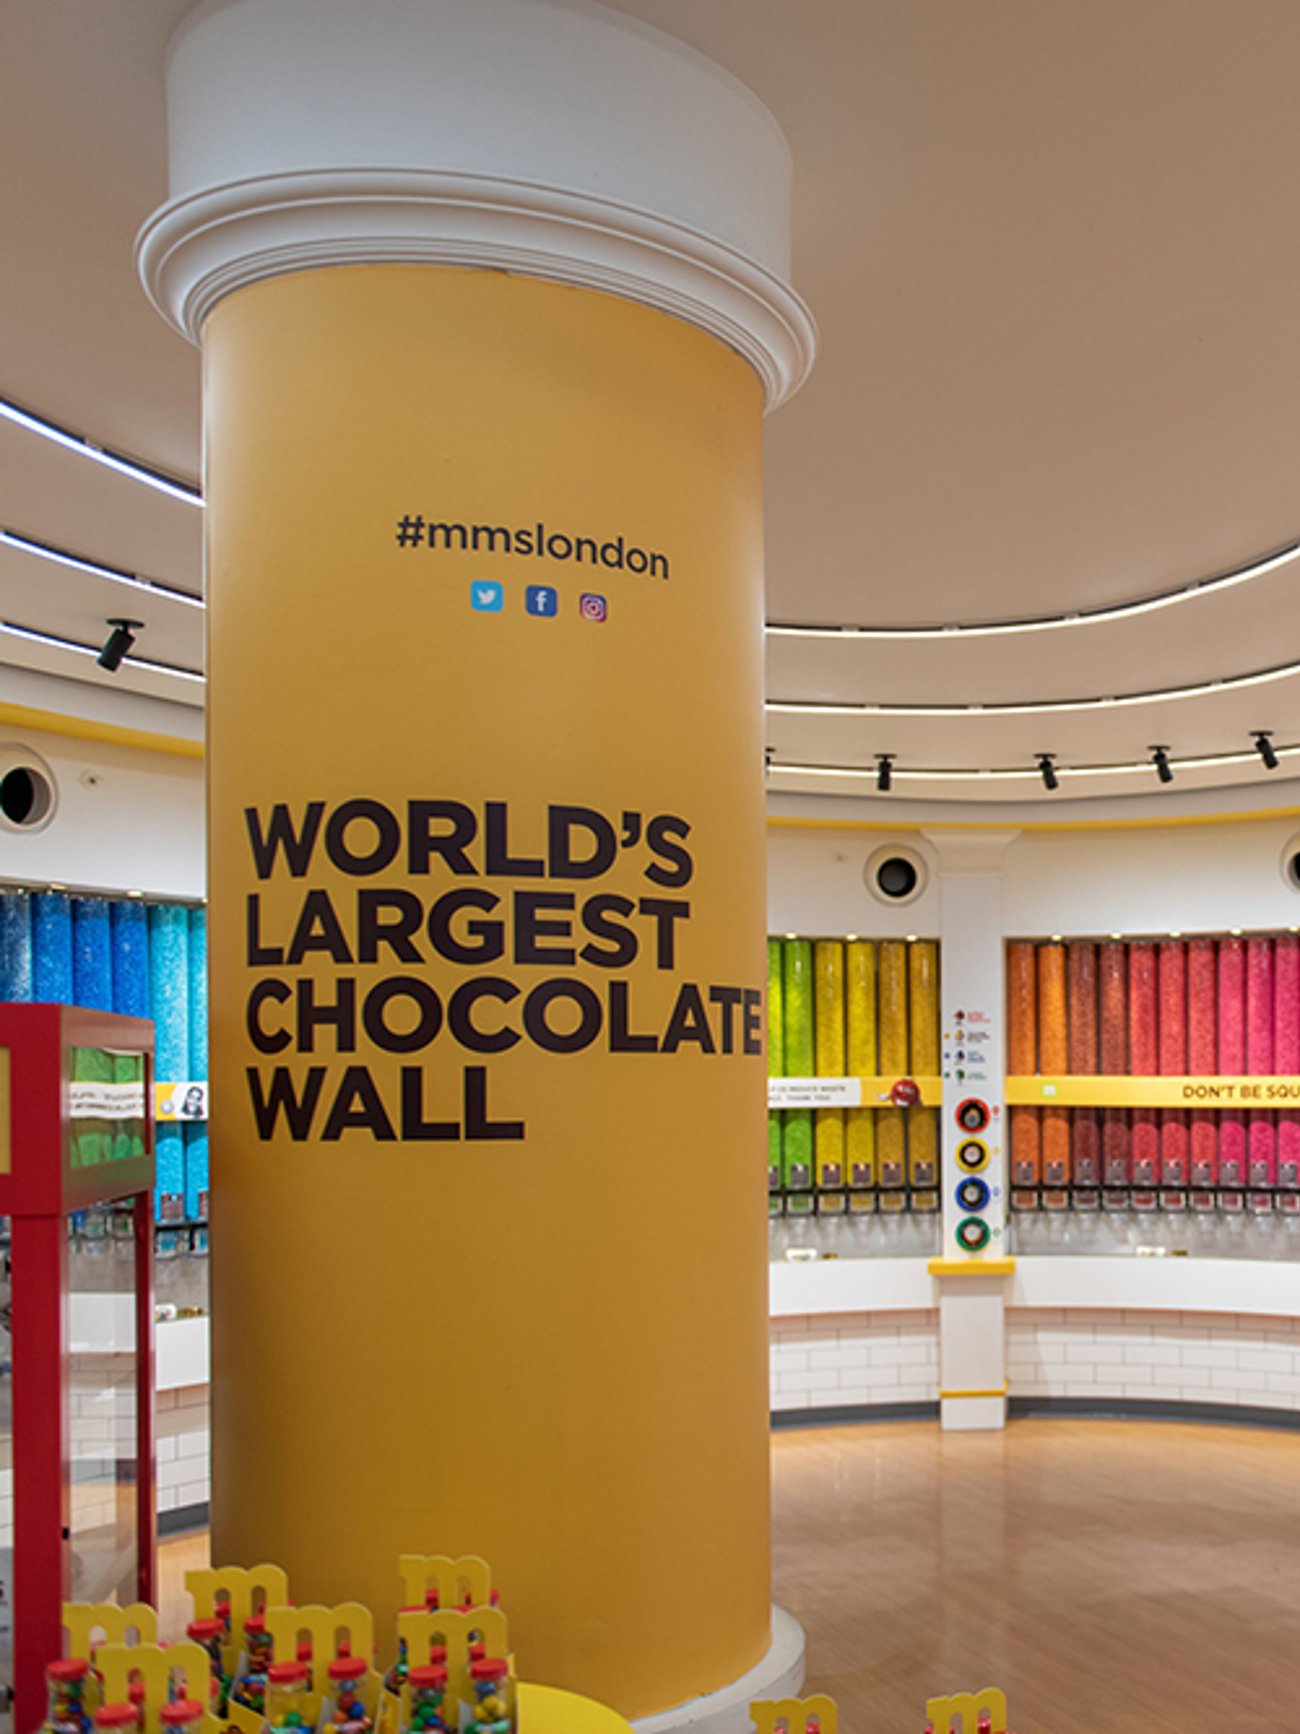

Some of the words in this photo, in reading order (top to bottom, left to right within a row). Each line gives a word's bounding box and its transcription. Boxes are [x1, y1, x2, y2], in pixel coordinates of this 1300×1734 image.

[397, 515, 669, 580] #mmslondon
[244, 798, 694, 889] WORLD'S
[246, 887, 690, 970] LARGEST
[246, 976, 762, 1056] CHOCOLATE
[246, 1066, 525, 1142] WALL
[1182, 1084, 1235, 1099] DON'T
[1240, 1085, 1261, 1099] BE
